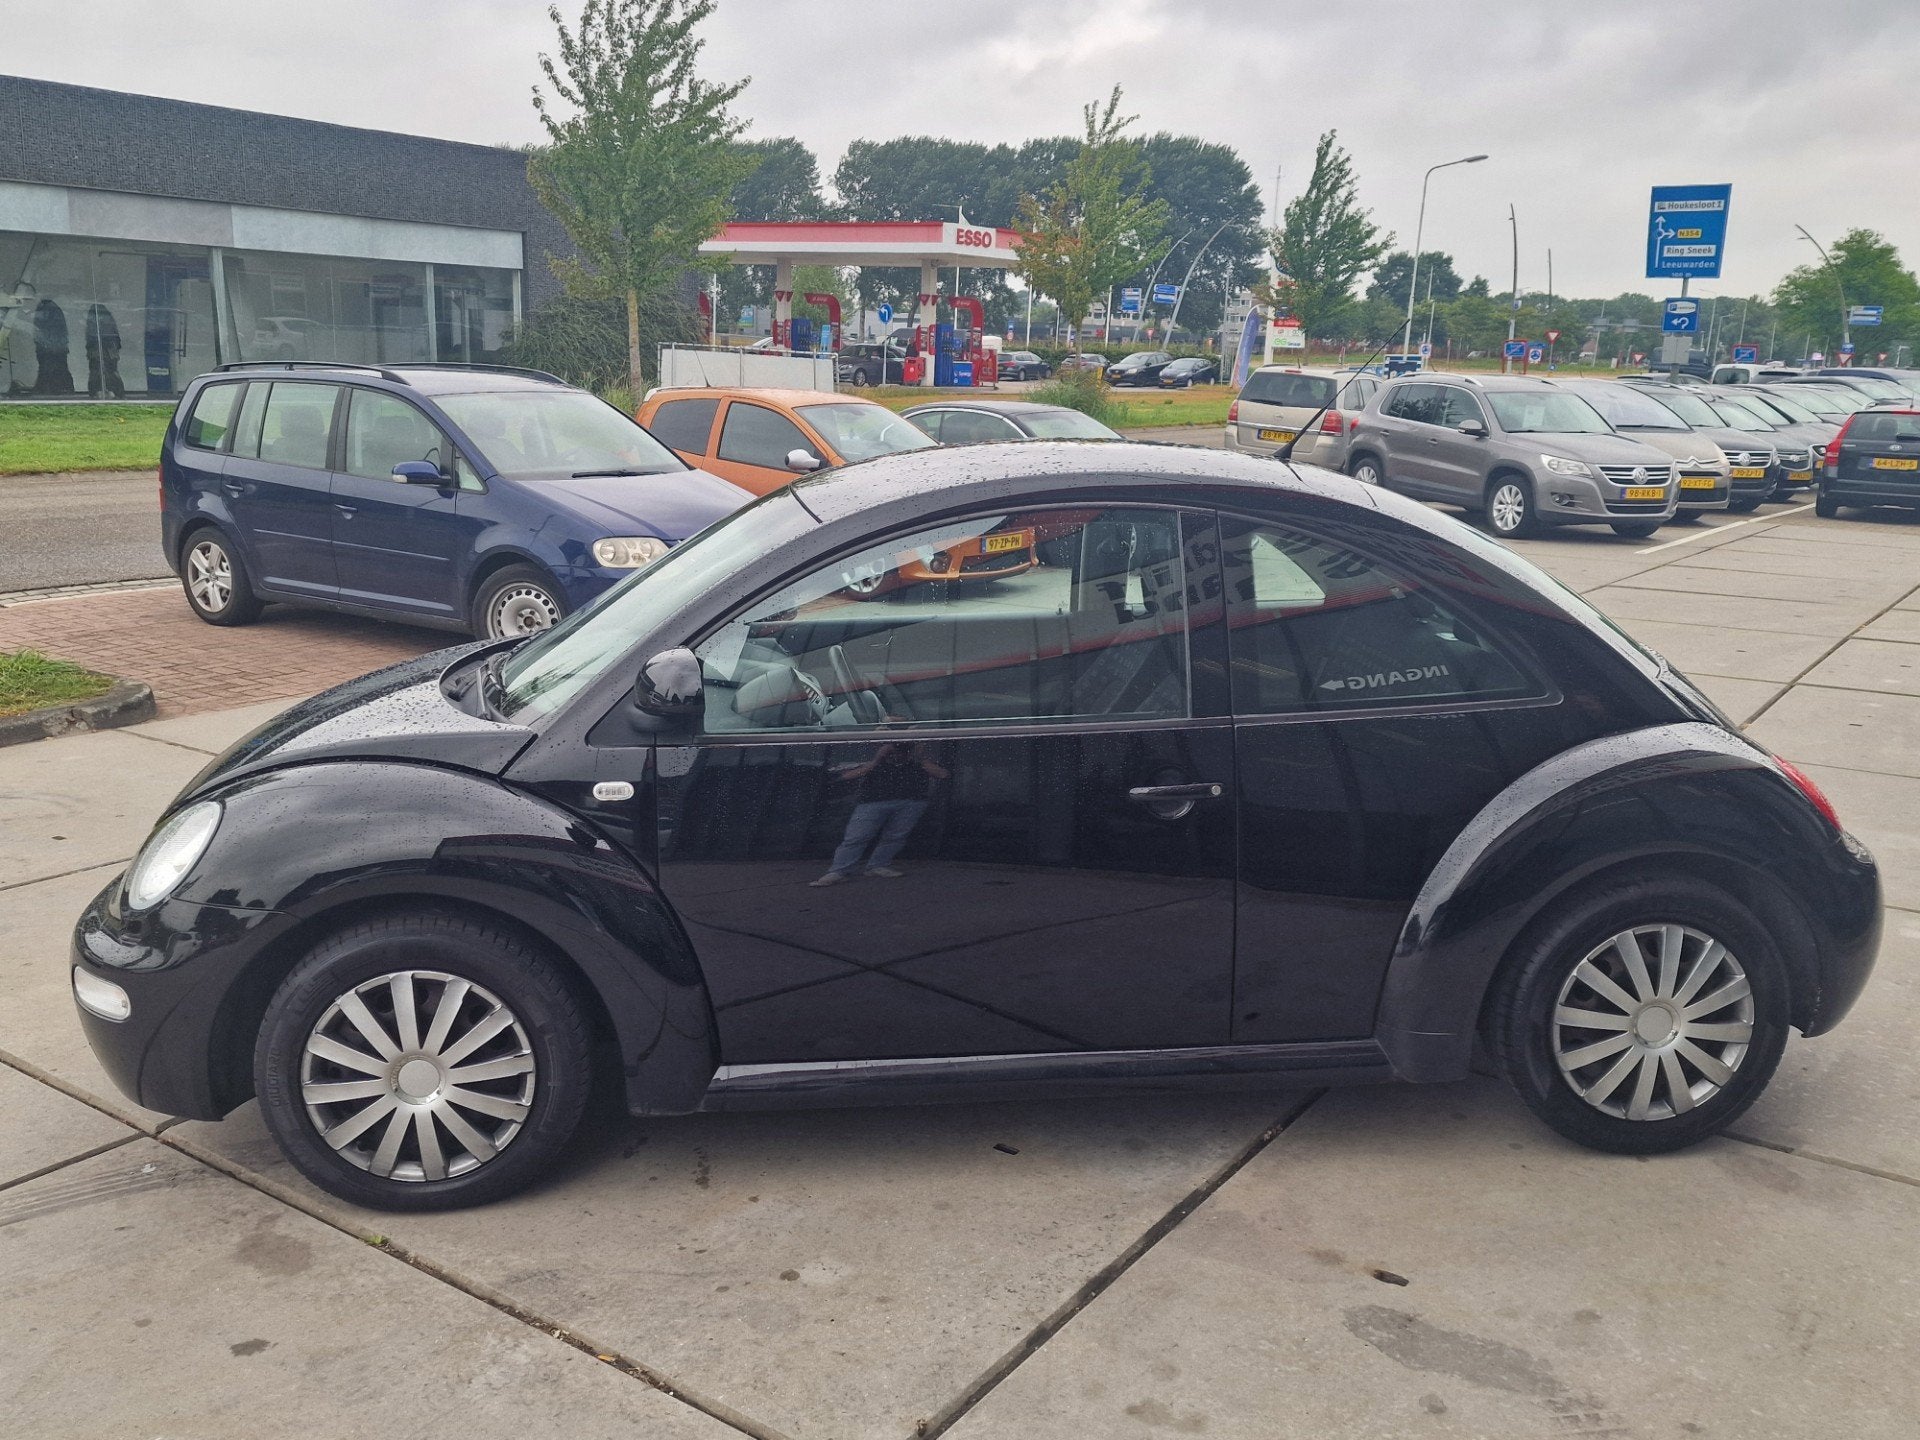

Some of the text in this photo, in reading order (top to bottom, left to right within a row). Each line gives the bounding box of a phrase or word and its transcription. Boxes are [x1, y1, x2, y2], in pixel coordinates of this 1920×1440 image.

[1668, 201, 1715, 209] Houkesloot
[956, 228, 992, 248] ESSO
[1666, 246, 1712, 255] Ring Sneek
[1661, 260, 1716, 268] Leeuwarden
